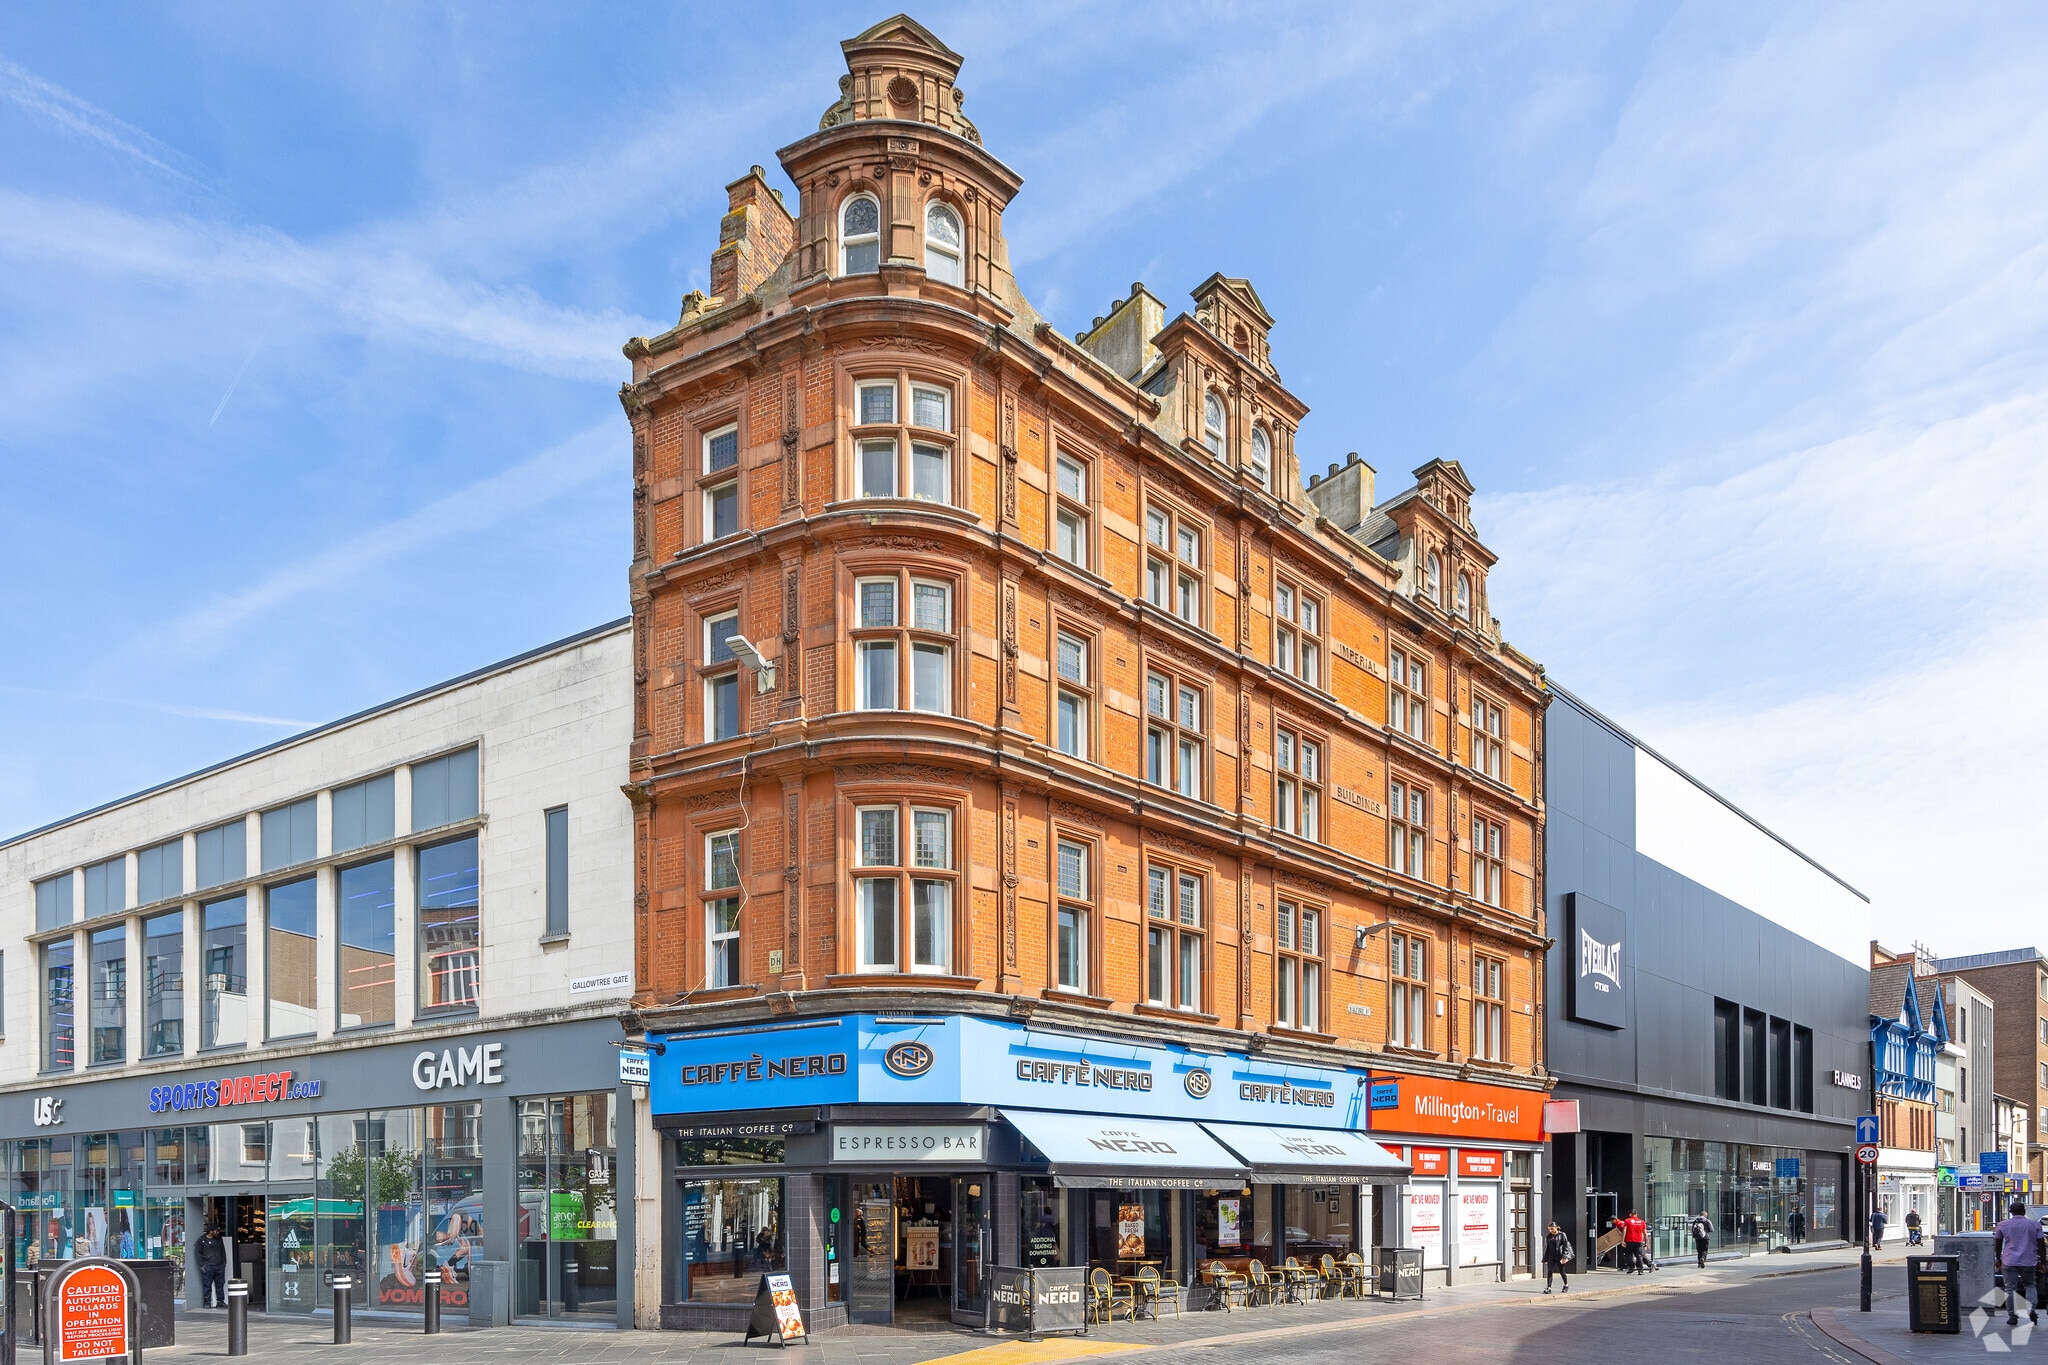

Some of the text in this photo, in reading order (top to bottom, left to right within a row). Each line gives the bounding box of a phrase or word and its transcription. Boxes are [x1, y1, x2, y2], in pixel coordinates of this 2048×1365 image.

[1339, 643, 1379, 675] IMPERIAL
[1337, 786, 1381, 814] BUILDINGS
[1581, 927, 1621, 990] EVERLAST
[572, 975, 629, 990] GALLOWTREE GATE
[413, 1042, 503, 1090] GAME
[622, 1065, 648, 1076] NERO
[681, 1053, 847, 1085] CAFFÈ NERO
[1017, 1058, 1153, 1091] CAFFÈ NERO
[1834, 1069, 1862, 1090] FLANNELS
[1240, 1081, 1335, 1107] CAFFÈ NERO
[1372, 1095, 1397, 1103] NERO
[33, 1096, 64, 1126] USC
[1415, 1094, 1519, 1123] Millington Travel
[679, 1128, 694, 1137] THE
[699, 1127, 733, 1136] ITALIAN
[738, 1124, 775, 1134] COFFEE
[839, 1136, 977, 1150] ESPRESSO BAR
[1087, 1137, 1178, 1154] NERO
[1279, 1143, 1347, 1156] NERO
[1859, 1150, 1876, 1159] 20
[1752, 1161, 1772, 1171] FLANNELS
[588, 1169, 610, 1179] GAME
[1302, 1175, 1313, 1183] THE
[1109, 1178, 1123, 1186] THE
[1128, 1178, 1157, 1187] ITALIAN
[1161, 1179, 1190, 1187] COFFEE
[577, 1220, 617, 1229] CLEARANC
[1398, 1267, 1420, 1278] NERO
[67, 1285, 119, 1295] CAUTION
[65, 1295, 121, 1305] AUTOMATIC
[993, 1290, 1021, 1305] NERO
[1038, 1291, 1080, 1305] NERO
[68, 1303, 119, 1312] BOLLARDS
[1938, 1284, 1949, 1325] Leicester
[66, 1317, 121, 1327] OPERATION
[76, 1339, 113, 1349] DO NOT
[72, 1346, 117, 1357] TAILGATE
